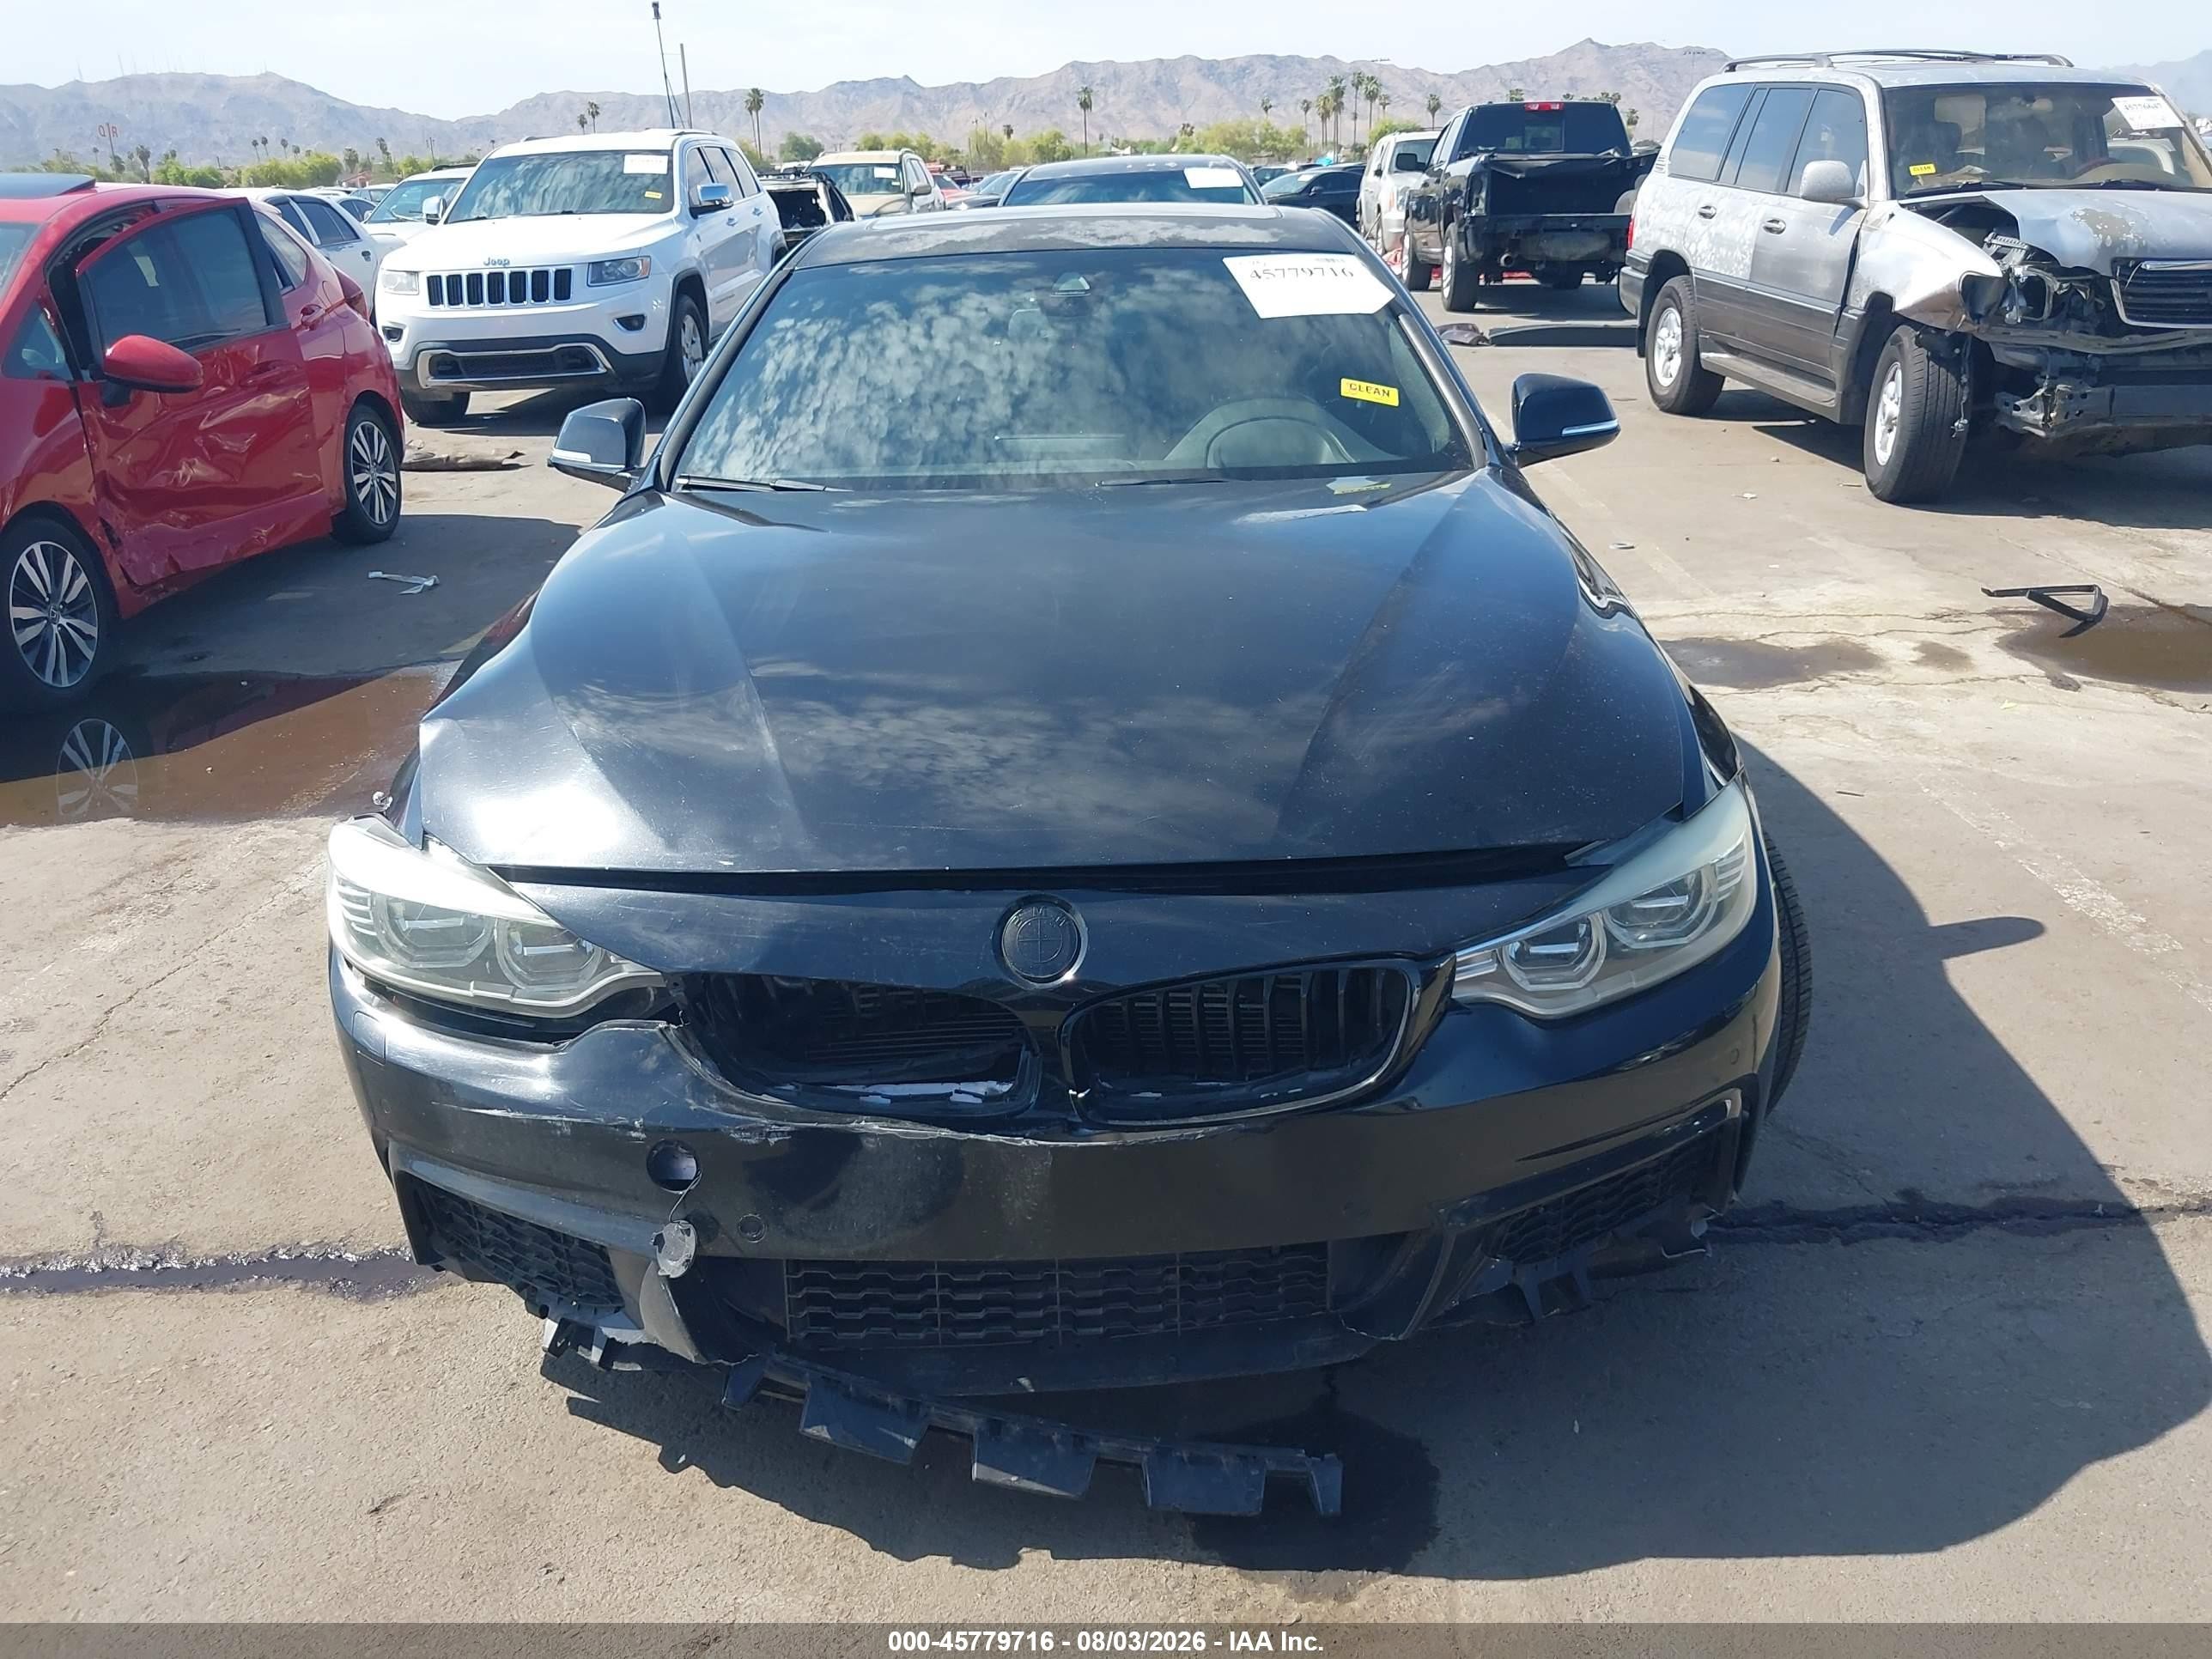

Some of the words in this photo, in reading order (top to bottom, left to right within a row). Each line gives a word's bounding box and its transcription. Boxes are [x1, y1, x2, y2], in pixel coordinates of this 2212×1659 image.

[483, 257, 510, 267] Jeep
[1249, 266, 1354, 280] 45779716
[1349, 383, 1390, 398] CLEAN
